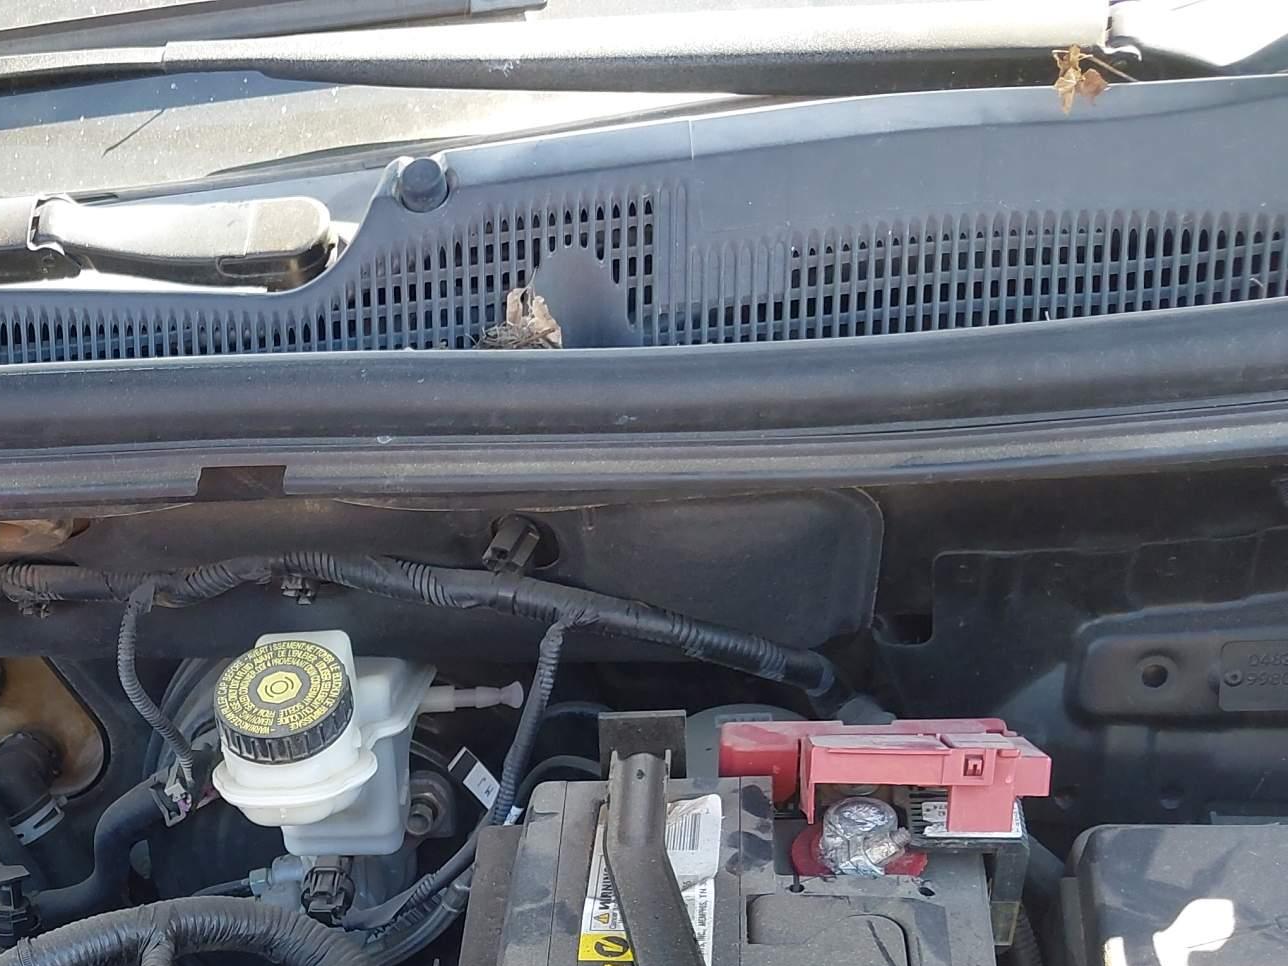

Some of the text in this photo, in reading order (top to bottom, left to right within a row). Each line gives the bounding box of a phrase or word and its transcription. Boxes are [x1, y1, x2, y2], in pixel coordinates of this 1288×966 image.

[277, 650, 287, 658] DE
[221, 659, 246, 681] BEFORE
[328, 662, 340, 671] LE
[217, 682, 229, 694] CAP
